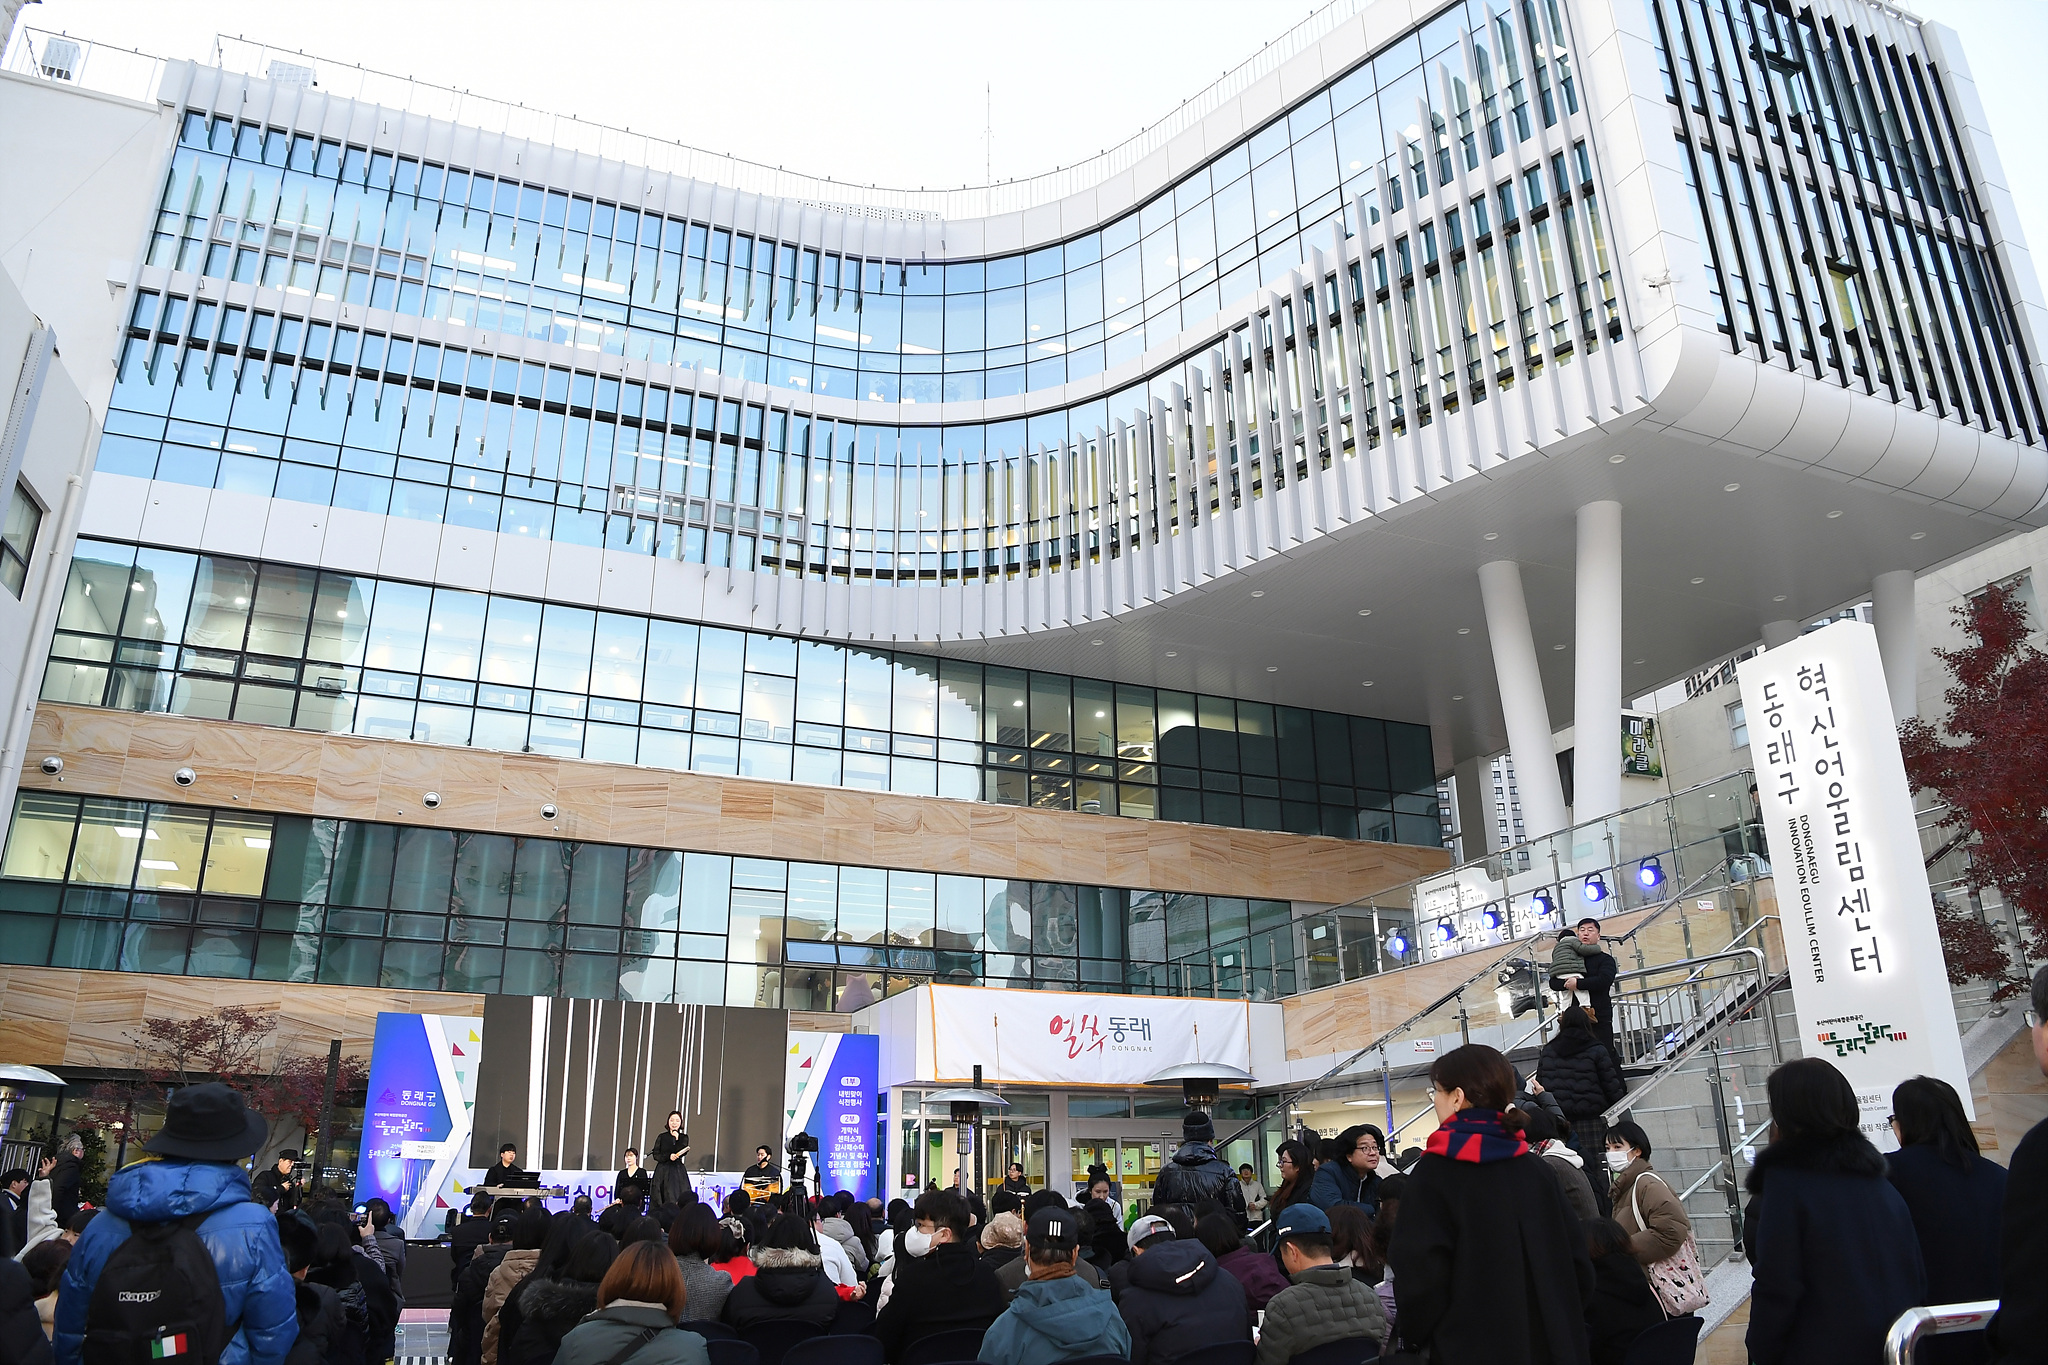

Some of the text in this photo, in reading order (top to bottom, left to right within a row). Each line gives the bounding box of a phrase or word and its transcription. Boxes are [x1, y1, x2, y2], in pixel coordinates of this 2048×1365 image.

[1763, 682, 1800, 805] 동래구
[1796, 663, 1882, 974] 혁신어울림센터
[1799, 814, 1820, 885] DONGNAEGU
[1788, 817, 1825, 984] INNOVATION EOULLIM CENTER
[1108, 1017, 1153, 1043] 동래
[401, 1090, 436, 1101] 동래구
[838, 1090, 862, 1098] 내빈맞이
[1857, 1094, 1881, 1104] 울림센터
[1860, 1123, 1873, 1133] 울림
[837, 1135, 862, 1143] 센터소개
[830, 1169, 842, 1177] 센터
